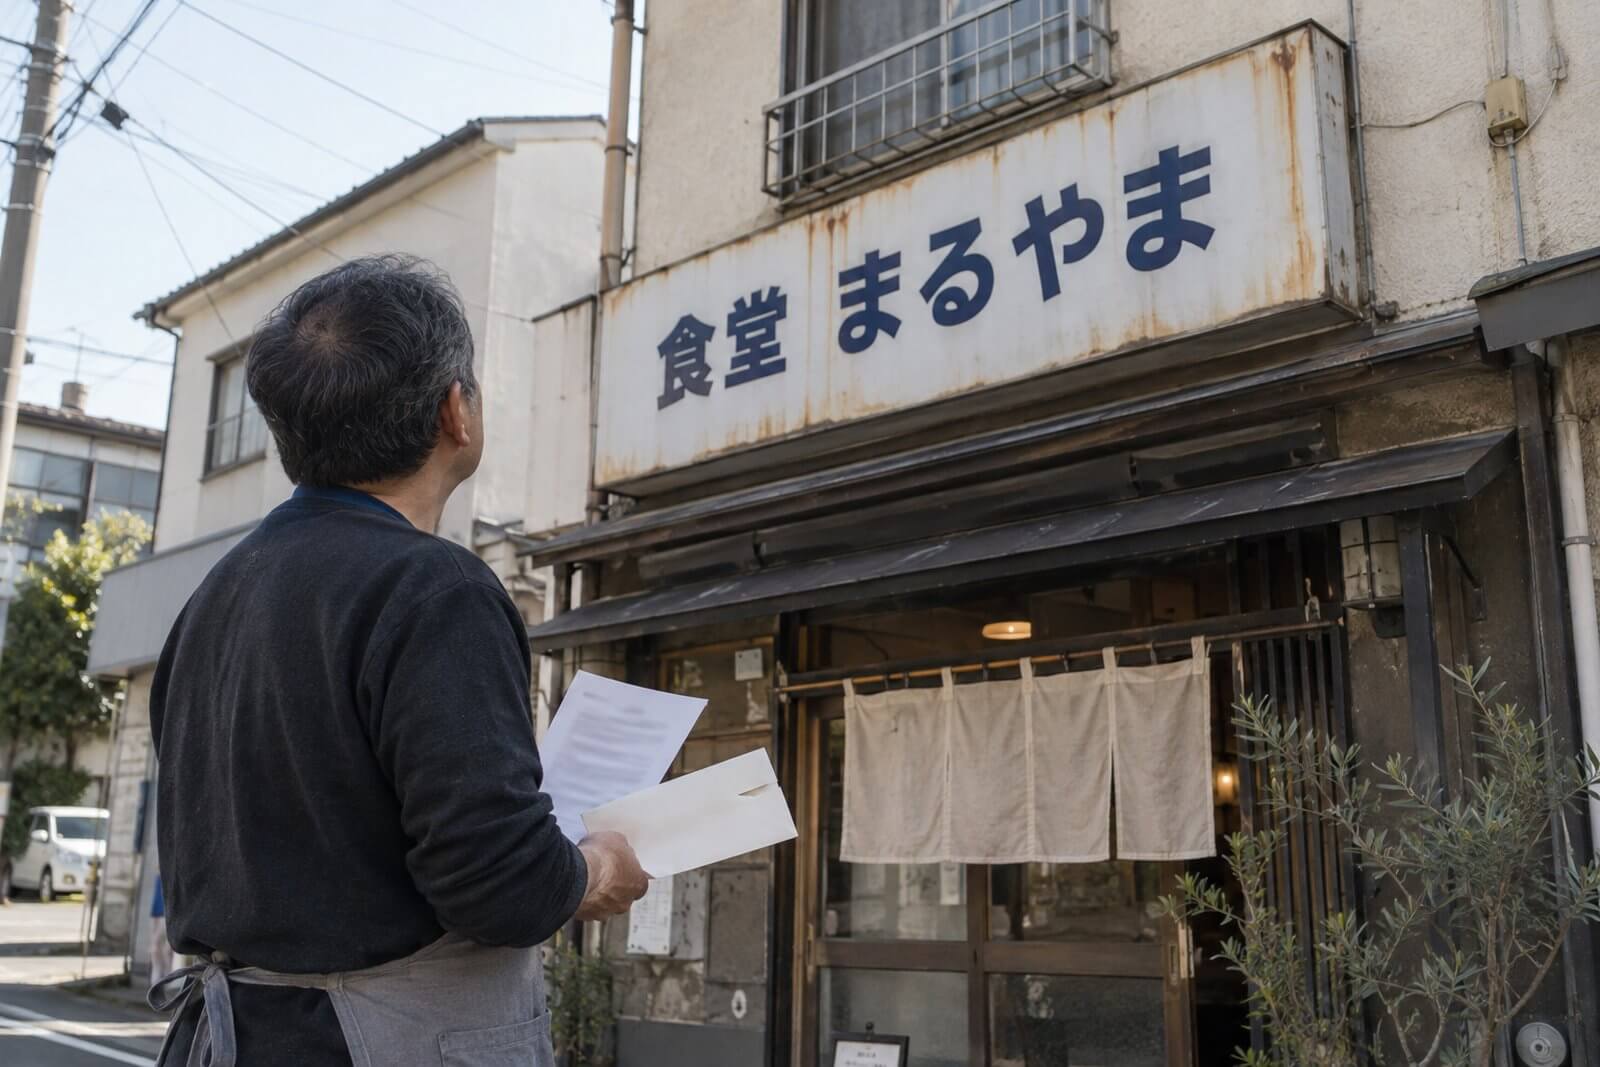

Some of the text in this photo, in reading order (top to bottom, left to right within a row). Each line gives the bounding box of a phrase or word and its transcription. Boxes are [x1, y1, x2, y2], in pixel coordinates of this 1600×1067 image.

[657, 145, 1216, 410] 食堂 まるやま
